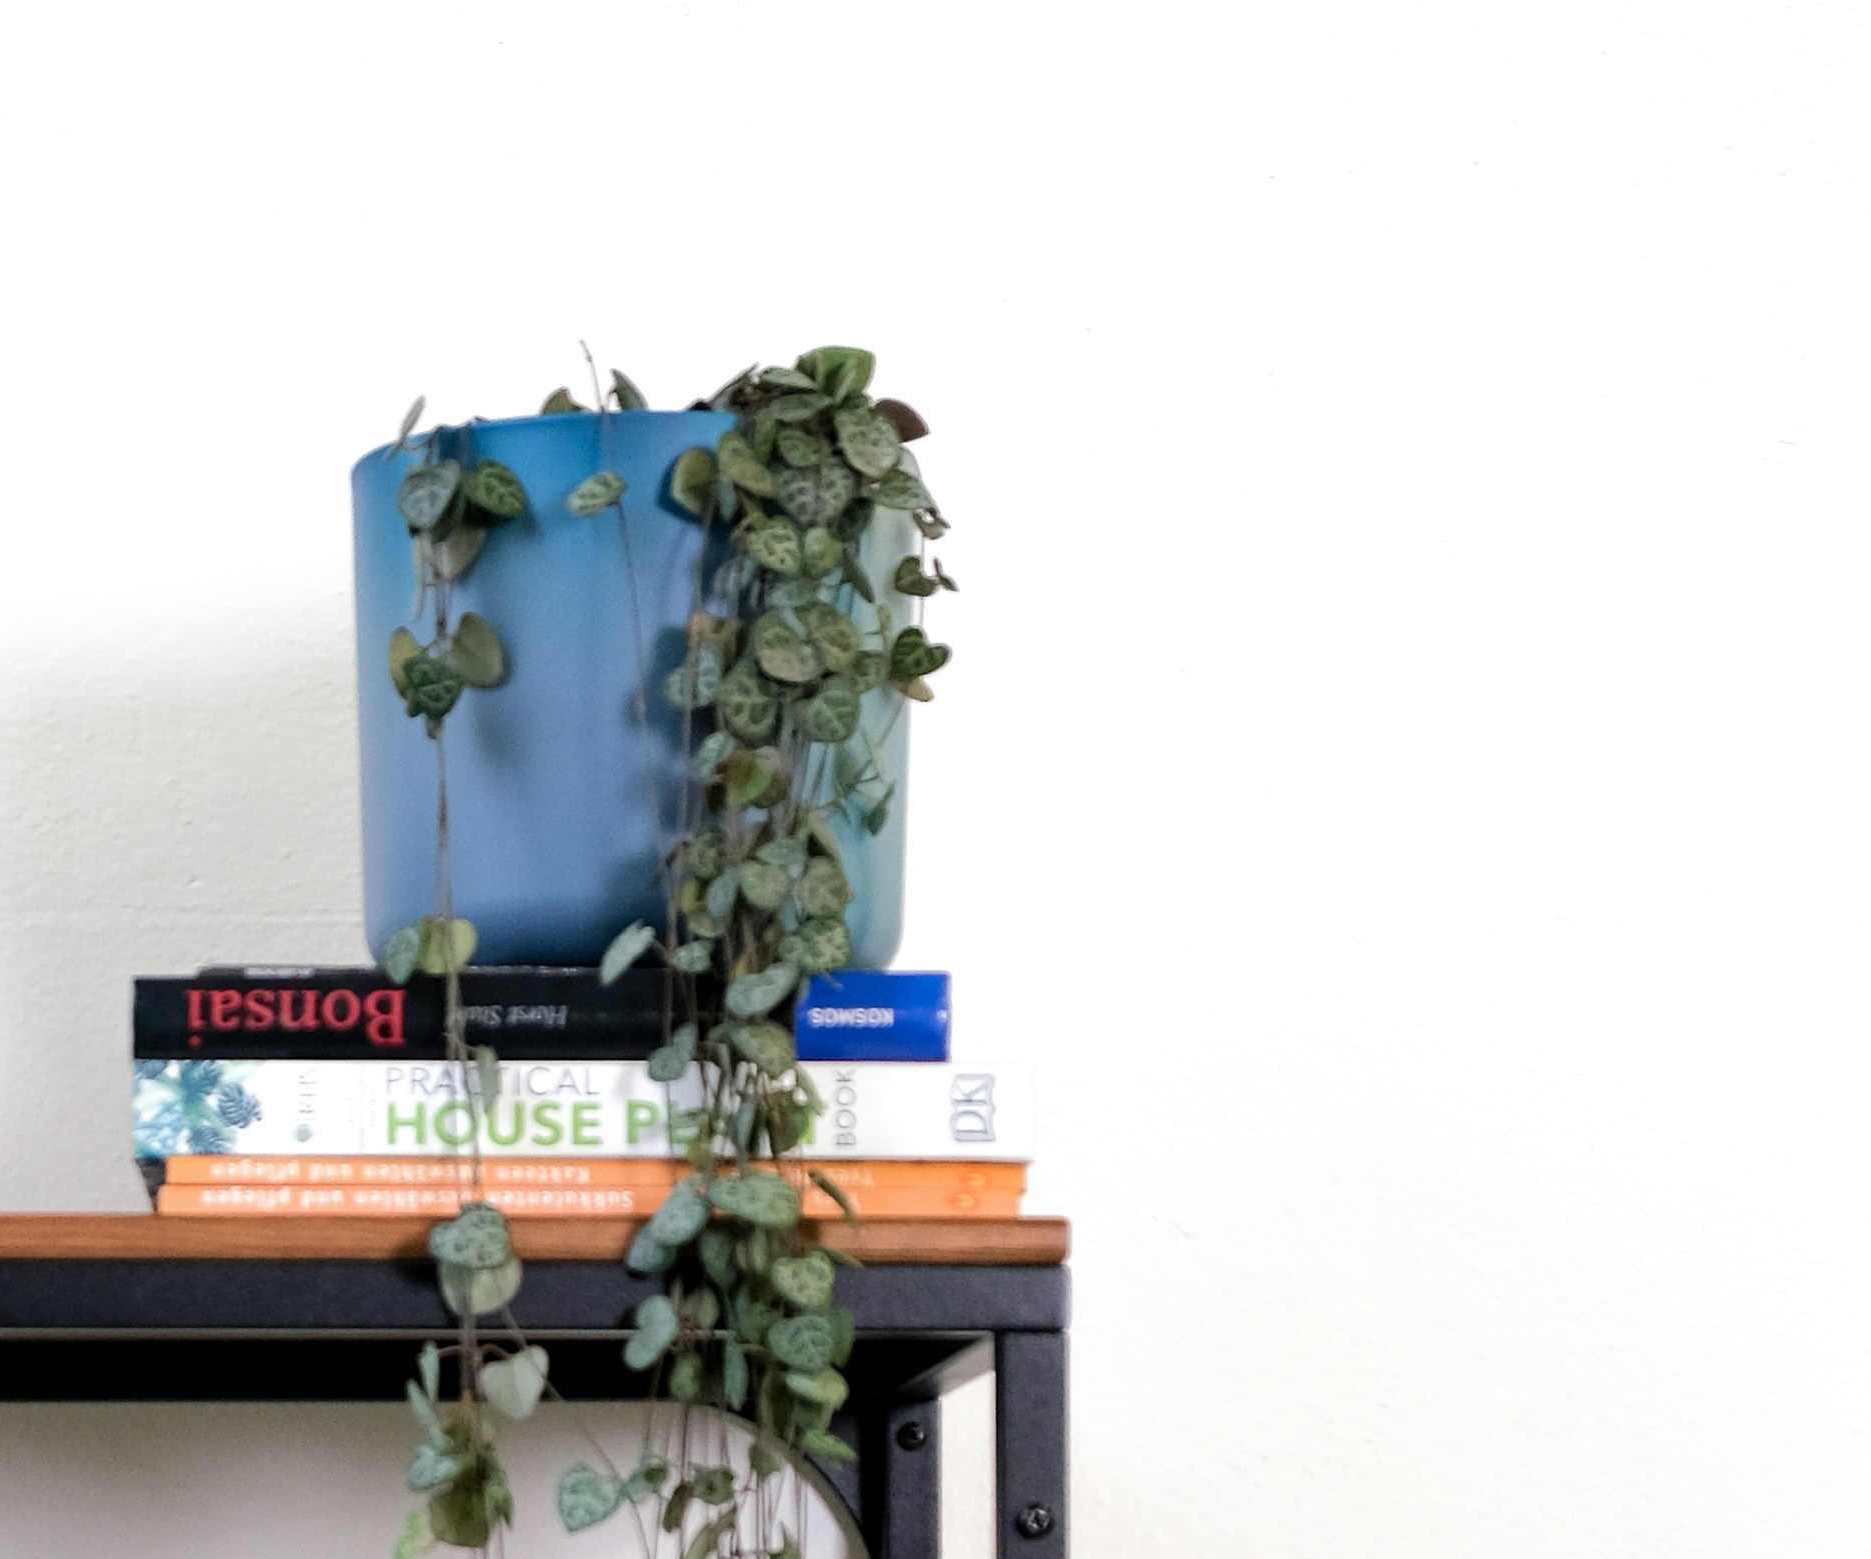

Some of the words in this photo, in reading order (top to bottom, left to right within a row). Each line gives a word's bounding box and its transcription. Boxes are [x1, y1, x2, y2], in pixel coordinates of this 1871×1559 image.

[186, 988, 406, 1047] Bonsai
[808, 1007, 894, 1028] KOSMOS
[832, 1069, 857, 1147] BOOK
[950, 1073, 996, 1143] DK
[387, 1100, 603, 1146] HOUSE
[209, 1160, 301, 1183] pflegen
[308, 1162, 353, 1182] und
[201, 1186, 291, 1211] pflegen
[300, 1188, 344, 1209] und
